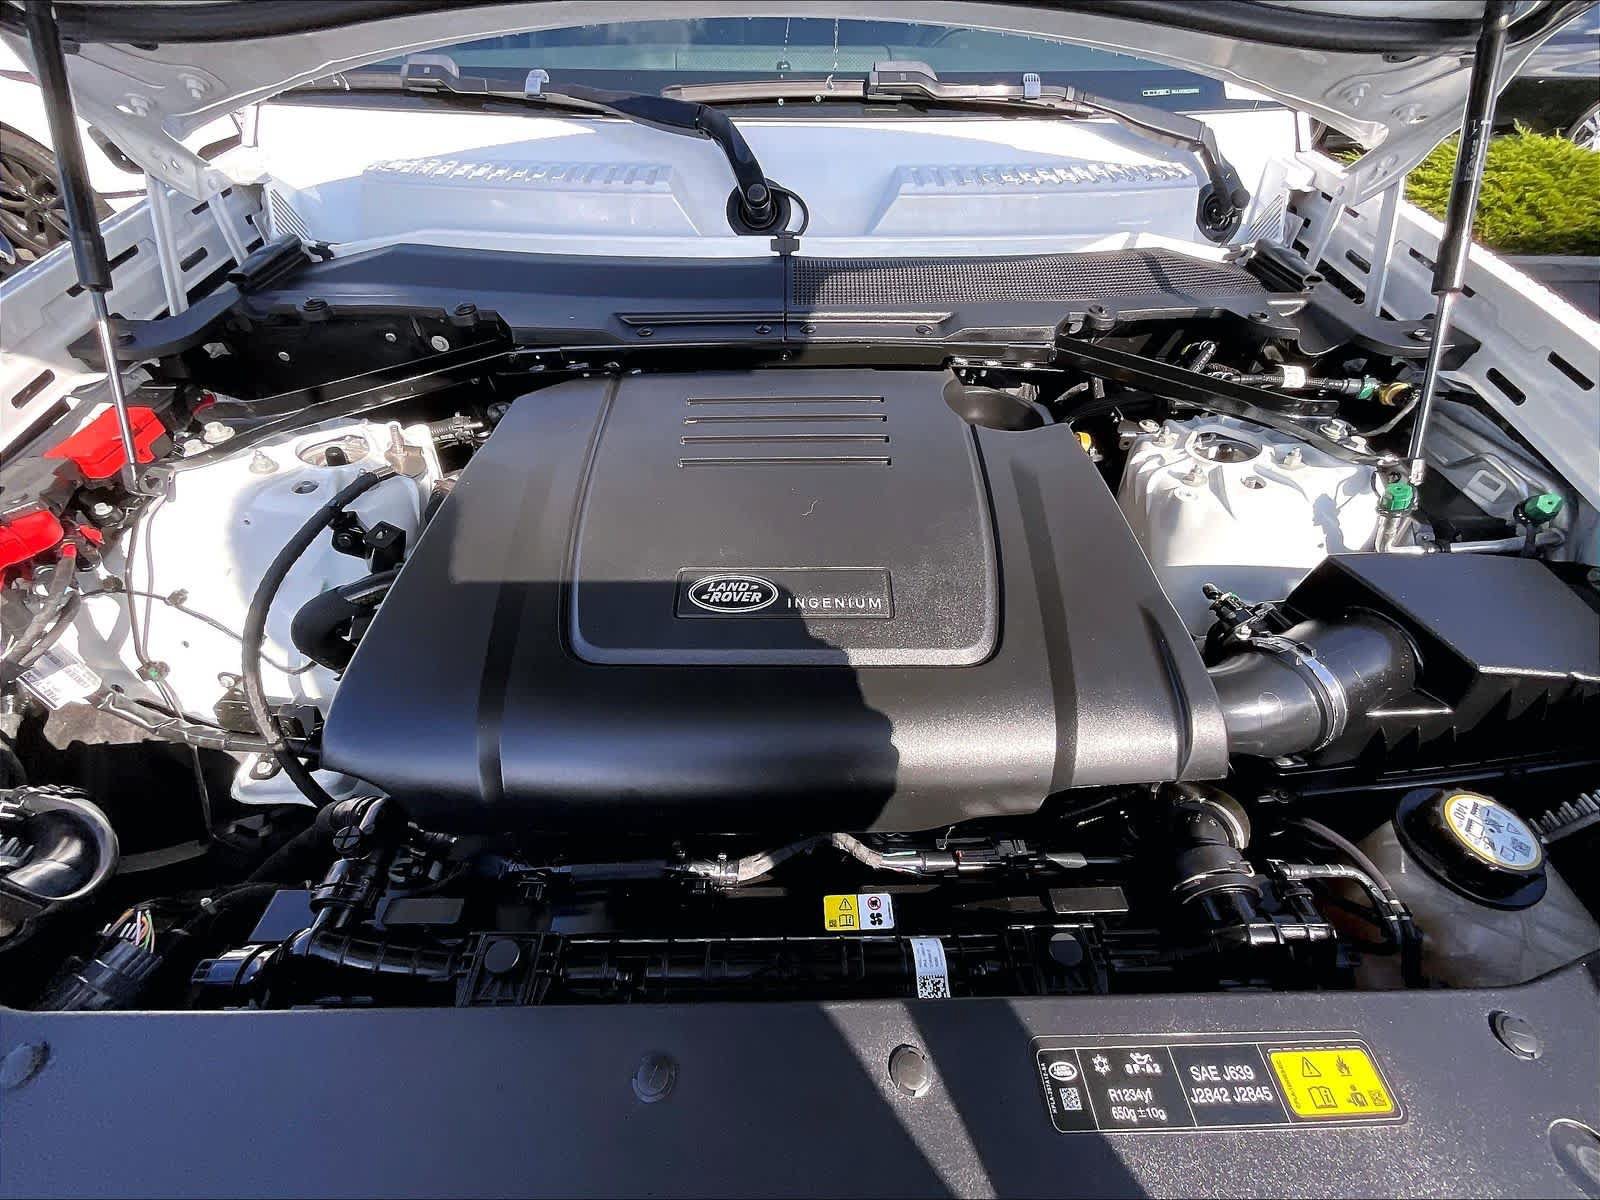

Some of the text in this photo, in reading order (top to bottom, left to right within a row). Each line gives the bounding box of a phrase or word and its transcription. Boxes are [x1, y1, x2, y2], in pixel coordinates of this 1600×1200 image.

[707, 582, 750, 592] LAND
[709, 591, 762, 602] ROVER
[787, 597, 882, 609] INGENIUM
[1190, 1065, 1254, 1081] SAE J639
[1108, 1088, 1153, 1104] R1234yf
[1191, 1086, 1273, 1103] J2842 J2845
